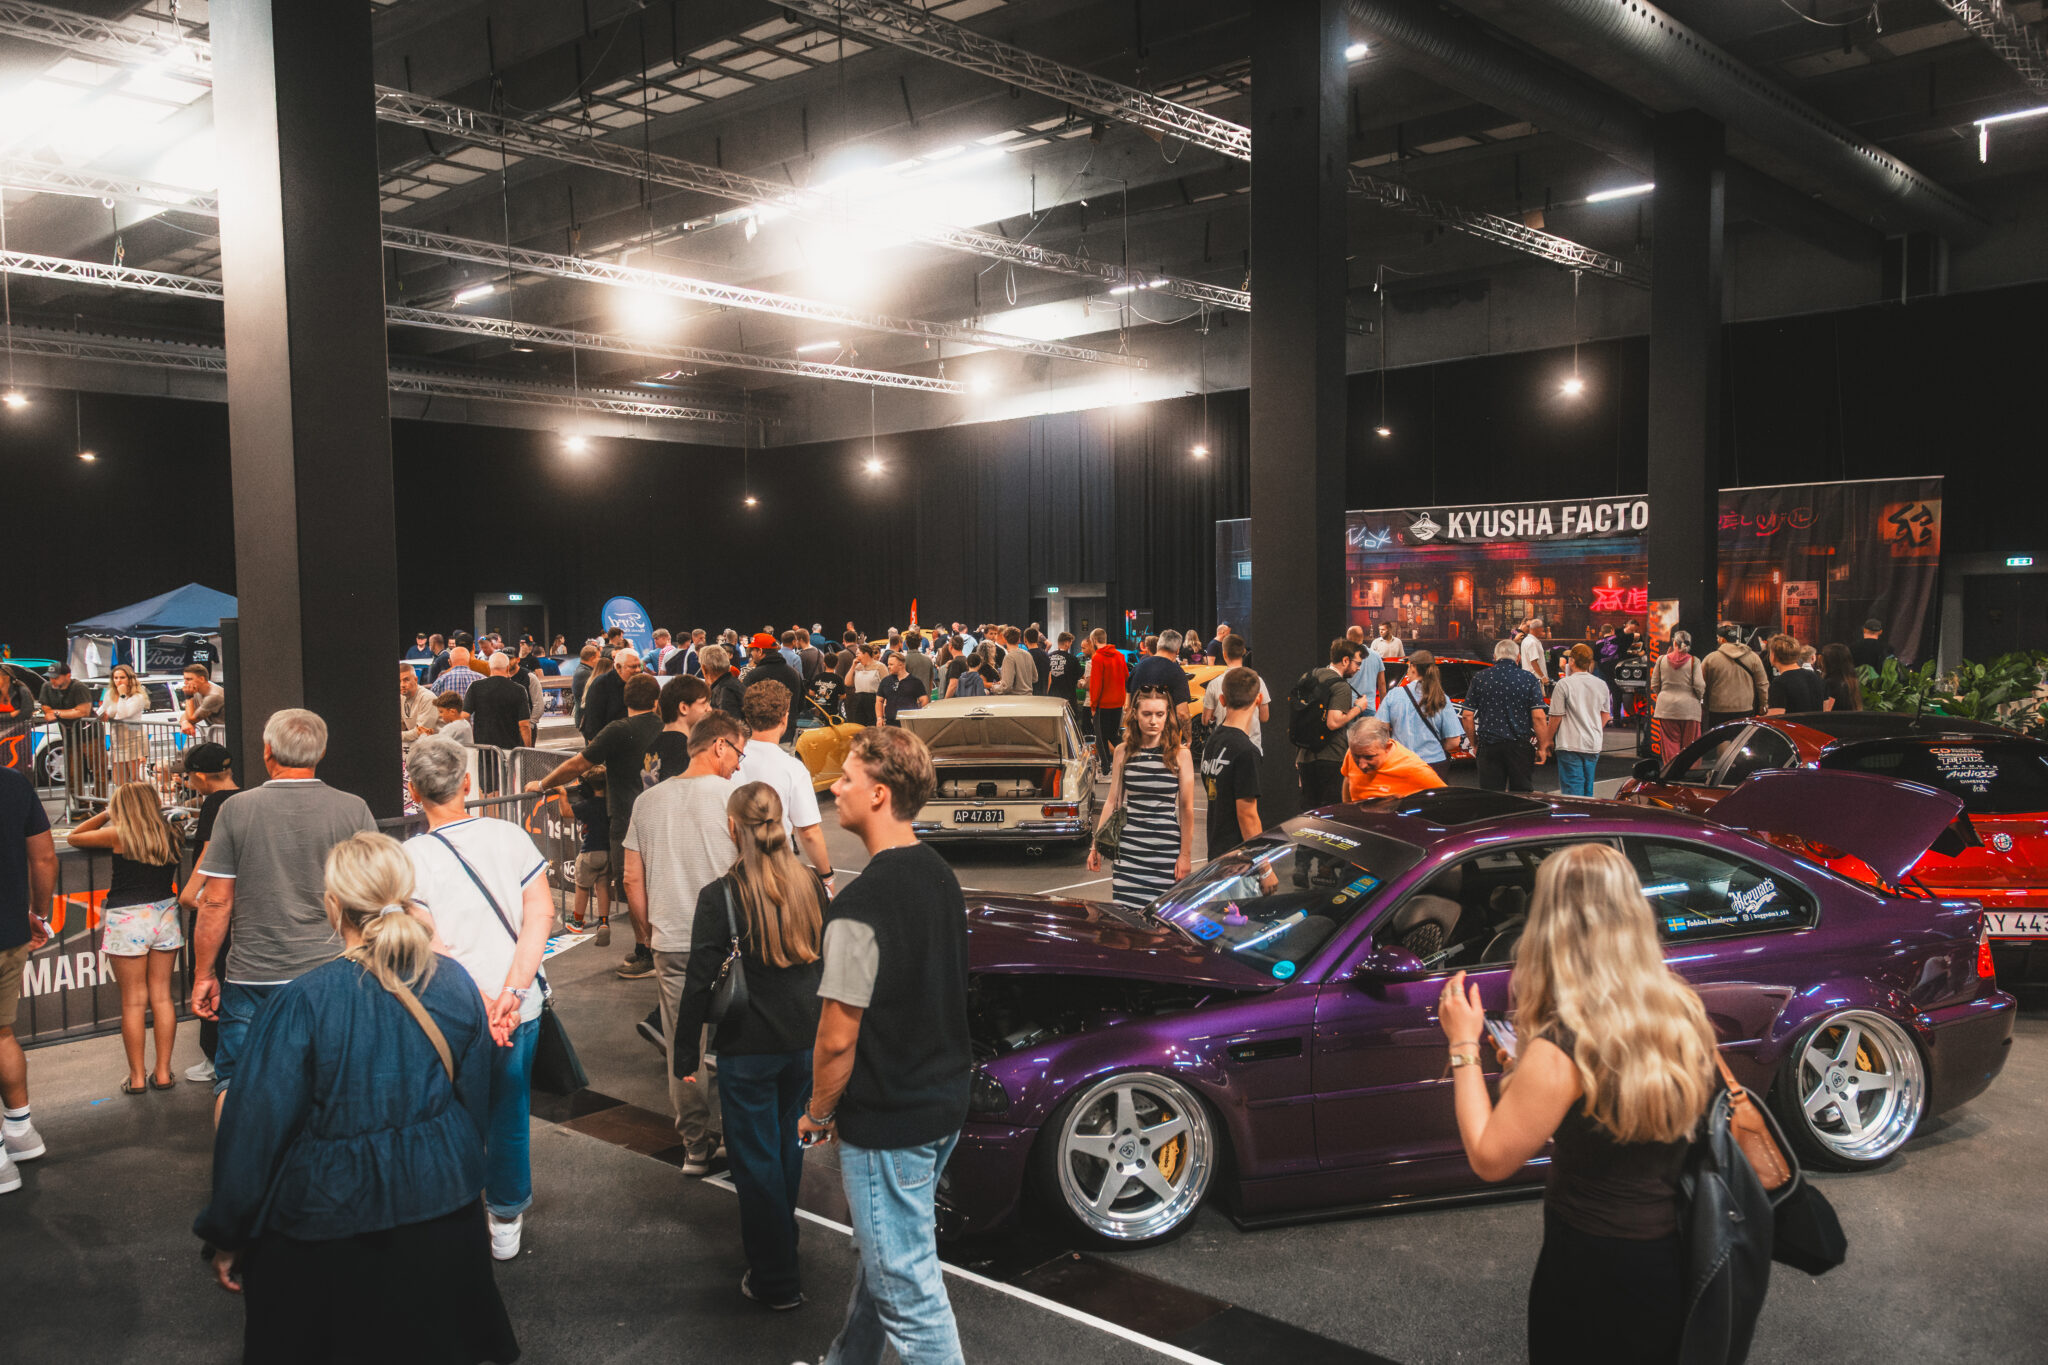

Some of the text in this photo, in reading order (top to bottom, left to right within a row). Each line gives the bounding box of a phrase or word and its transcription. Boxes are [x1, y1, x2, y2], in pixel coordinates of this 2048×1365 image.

[1447, 507, 1553, 538] KYUSHA
[146, 646, 186, 665] Ford
[955, 810, 1004, 822] AP 47.871
[1292, 830, 1354, 851] STYLE
[1686, 919, 1707, 928] Tobias
[21, 949, 117, 998] MARK
